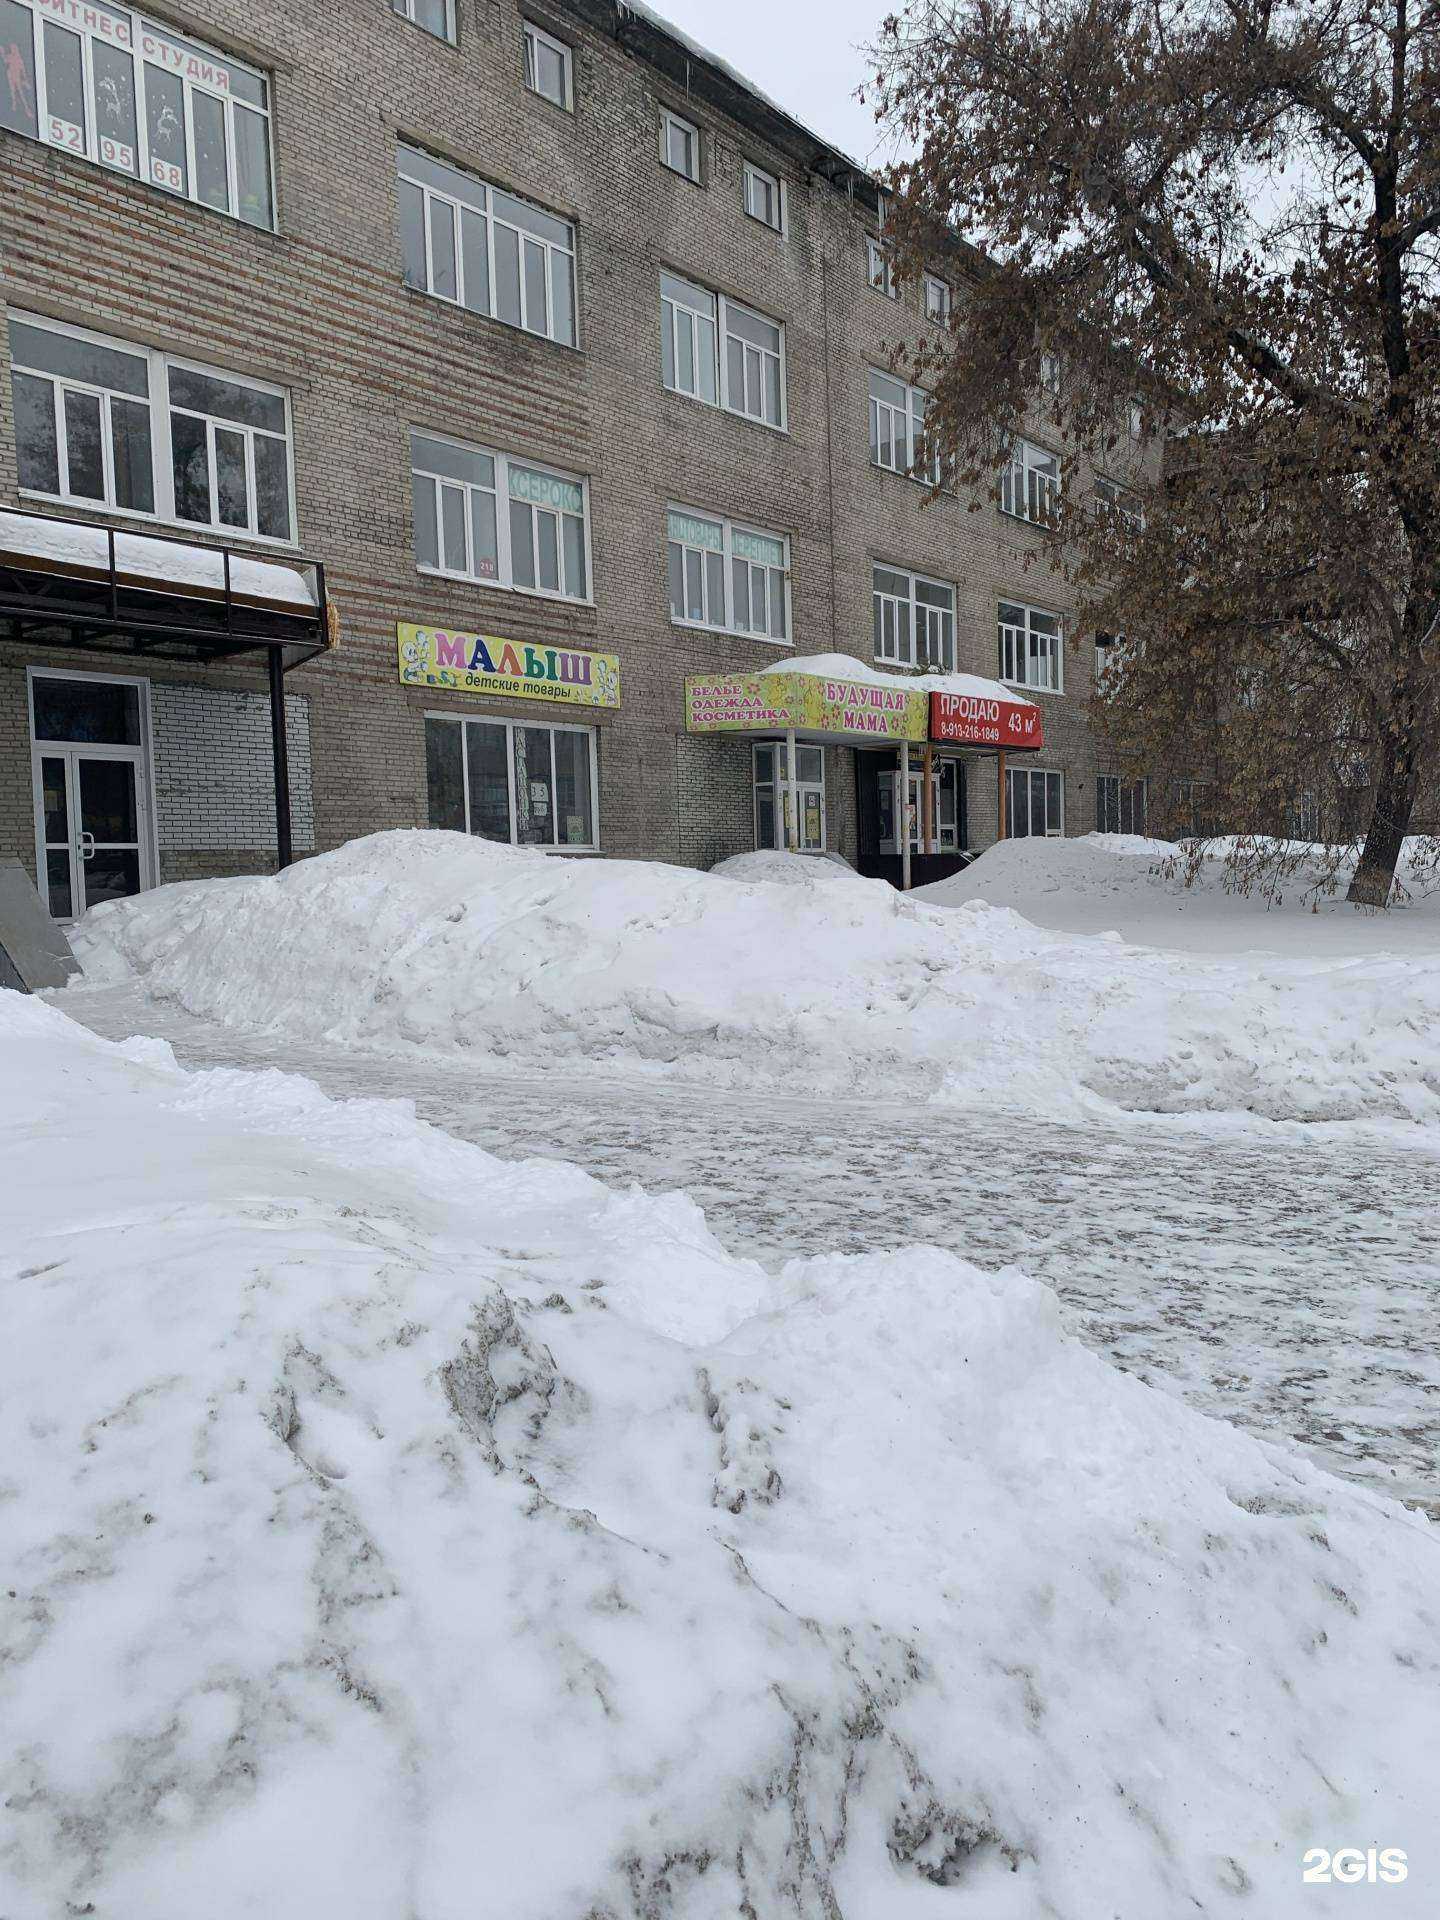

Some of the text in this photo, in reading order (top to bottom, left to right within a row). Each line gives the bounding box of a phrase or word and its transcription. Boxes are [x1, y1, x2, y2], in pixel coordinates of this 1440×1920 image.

[40, 0, 229, 90] ИТНЕС СТУДИЯ
[50, 119, 181, 188] 52 95 68
[434, 633, 592, 686] МАЛЫШ
[465, 671, 571, 698] детские товары
[691, 685, 743, 697] БЕЛЬЕ
[826, 681, 905, 711] БУДУЩАЯ
[691, 696, 764, 710] ОДЕЖДА
[691, 709, 791, 722] КОСМЕТИКА
[940, 693, 1000, 723] ПРОДАЮ
[843, 710, 888, 733] МАМА
[940, 721, 1000, 741] 8-913-216-1849
[1008, 712, 1022, 732] 43
